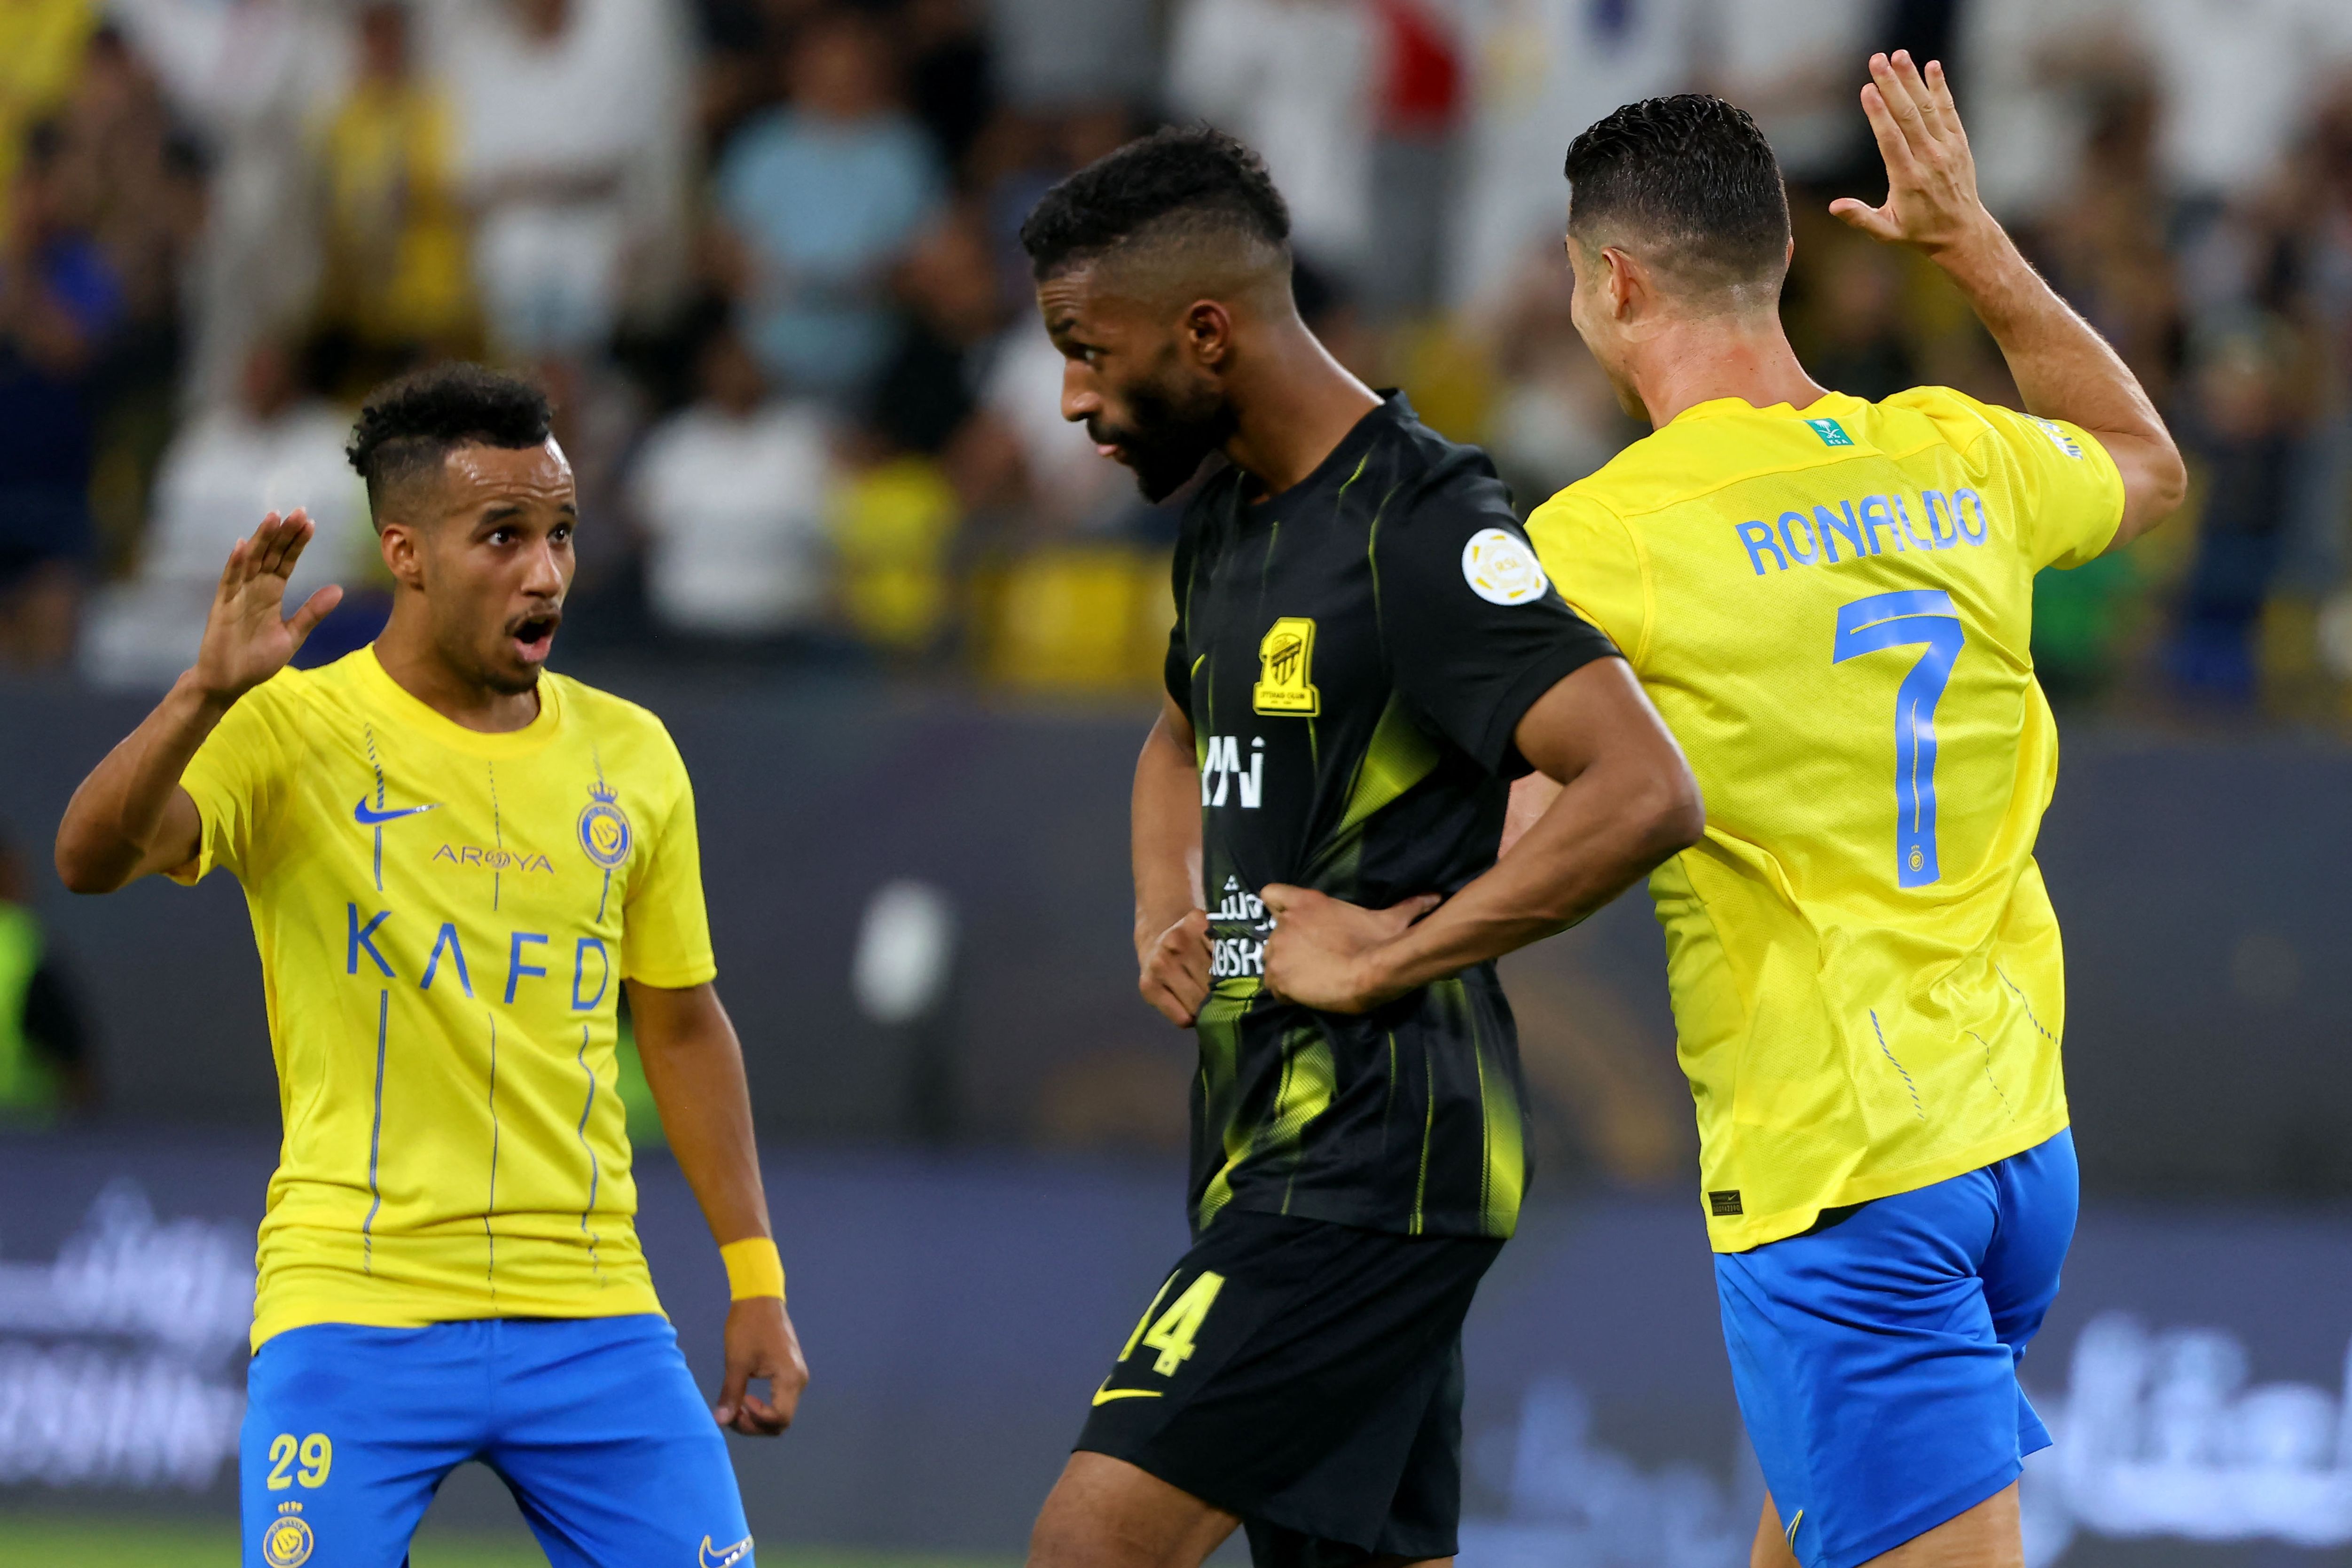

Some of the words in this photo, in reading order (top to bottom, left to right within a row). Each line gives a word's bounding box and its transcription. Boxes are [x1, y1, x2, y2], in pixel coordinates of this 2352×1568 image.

[1735, 487, 1988, 576] RONALDO
[1832, 589, 1965, 888] 7
[347, 902, 608, 1011] KAFD
[266, 1433, 333, 1491] 29
